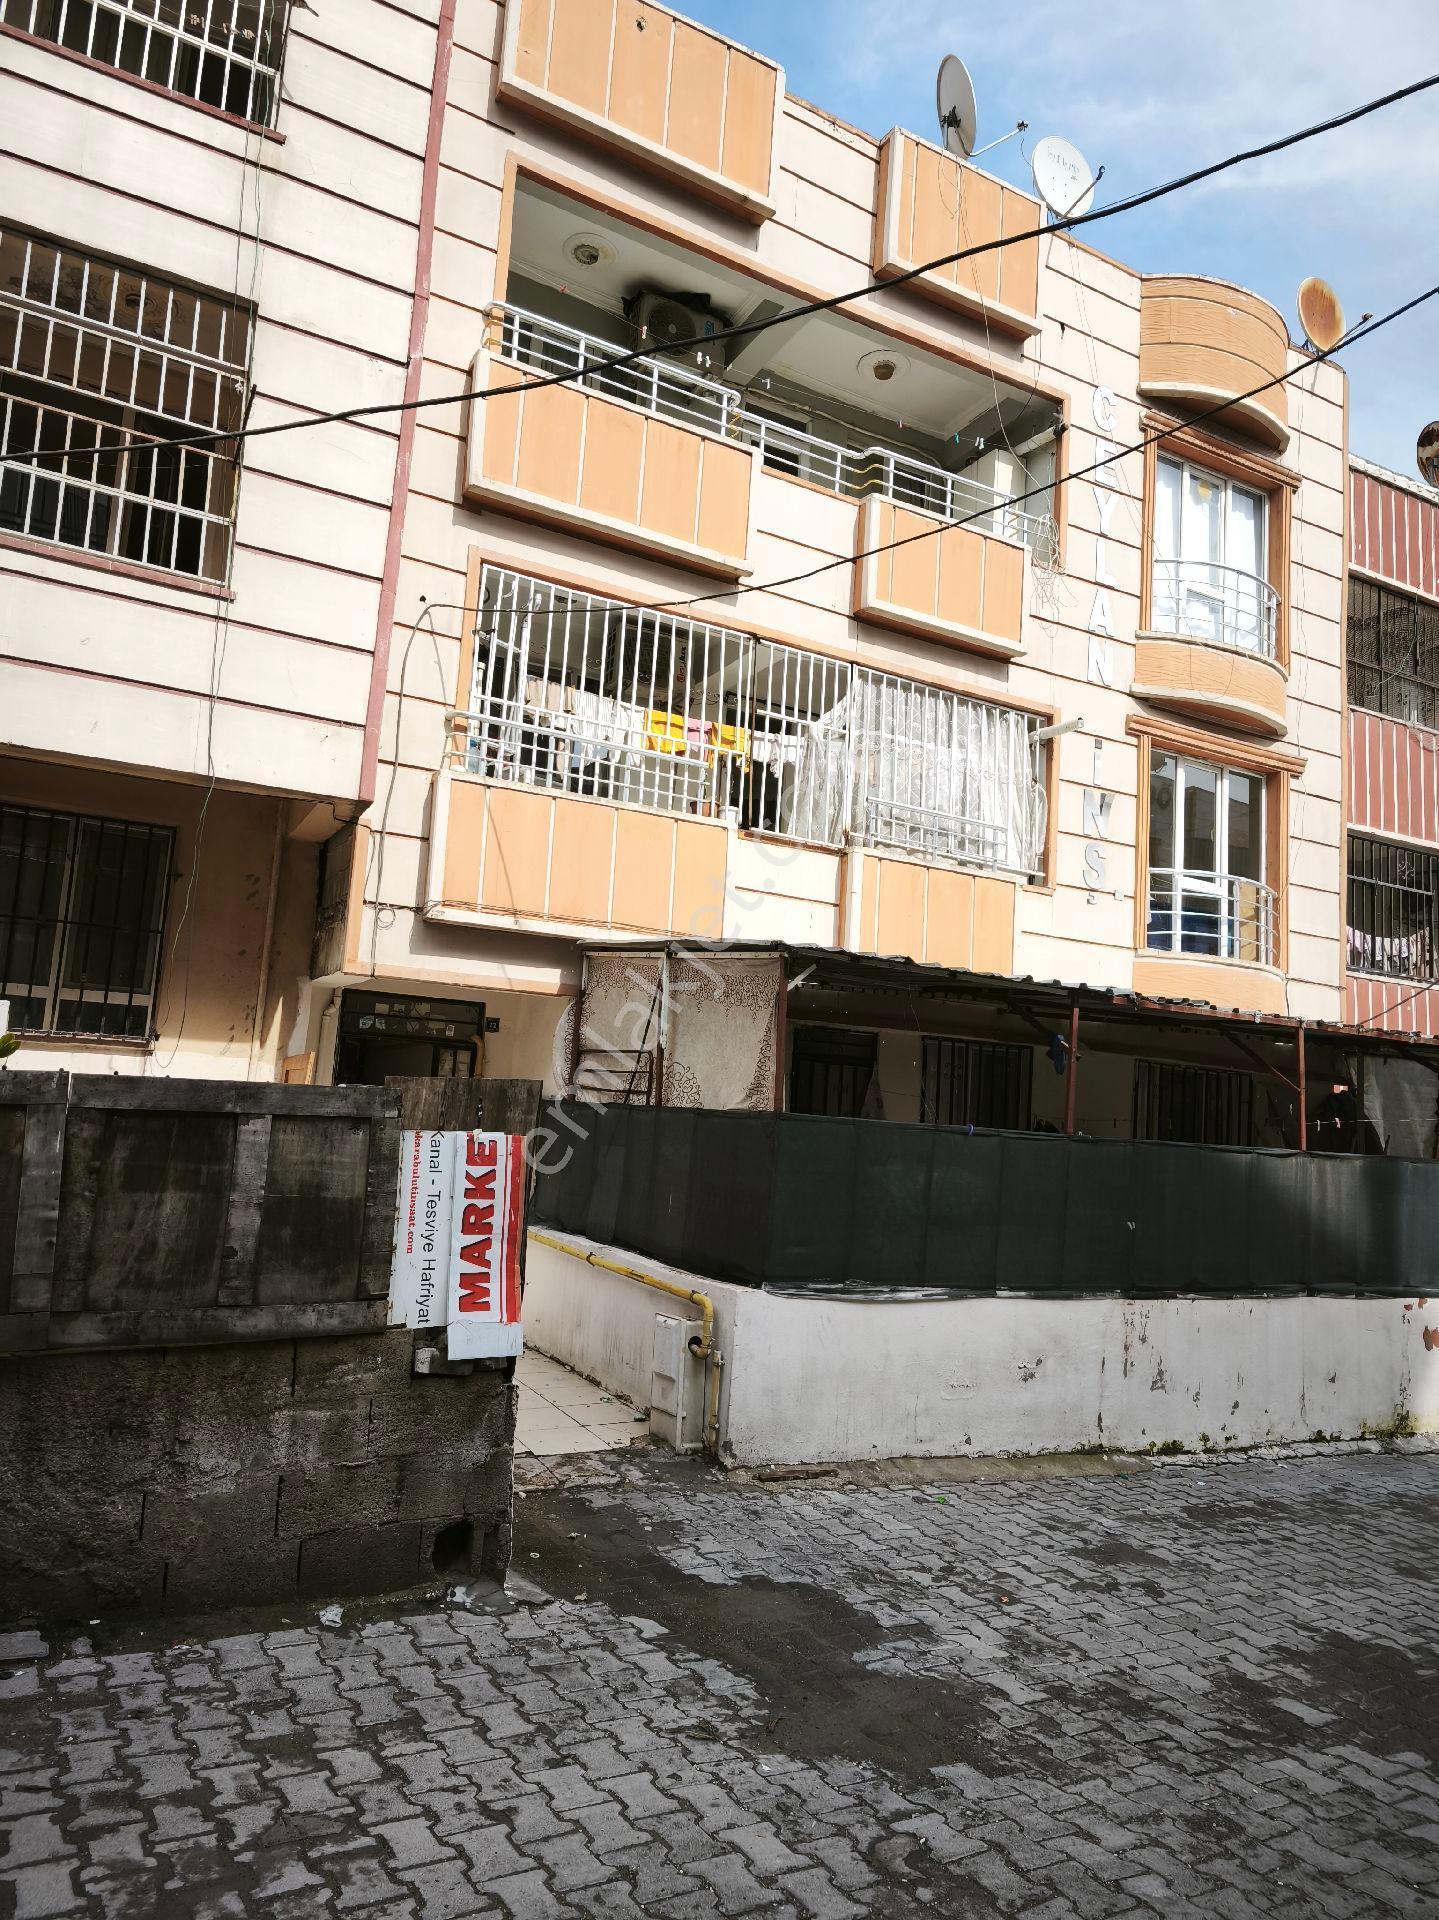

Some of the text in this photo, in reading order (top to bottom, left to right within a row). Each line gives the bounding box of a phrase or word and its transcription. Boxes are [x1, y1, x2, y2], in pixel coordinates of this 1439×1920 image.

[1087, 385, 1120, 687] CEYLAN
[428, 1130, 445, 1174] Kanal
[420, 1190, 442, 1253] Tesviye
[459, 1131, 498, 1313] MARKE
[416, 1258, 438, 1325] Hafriyat
